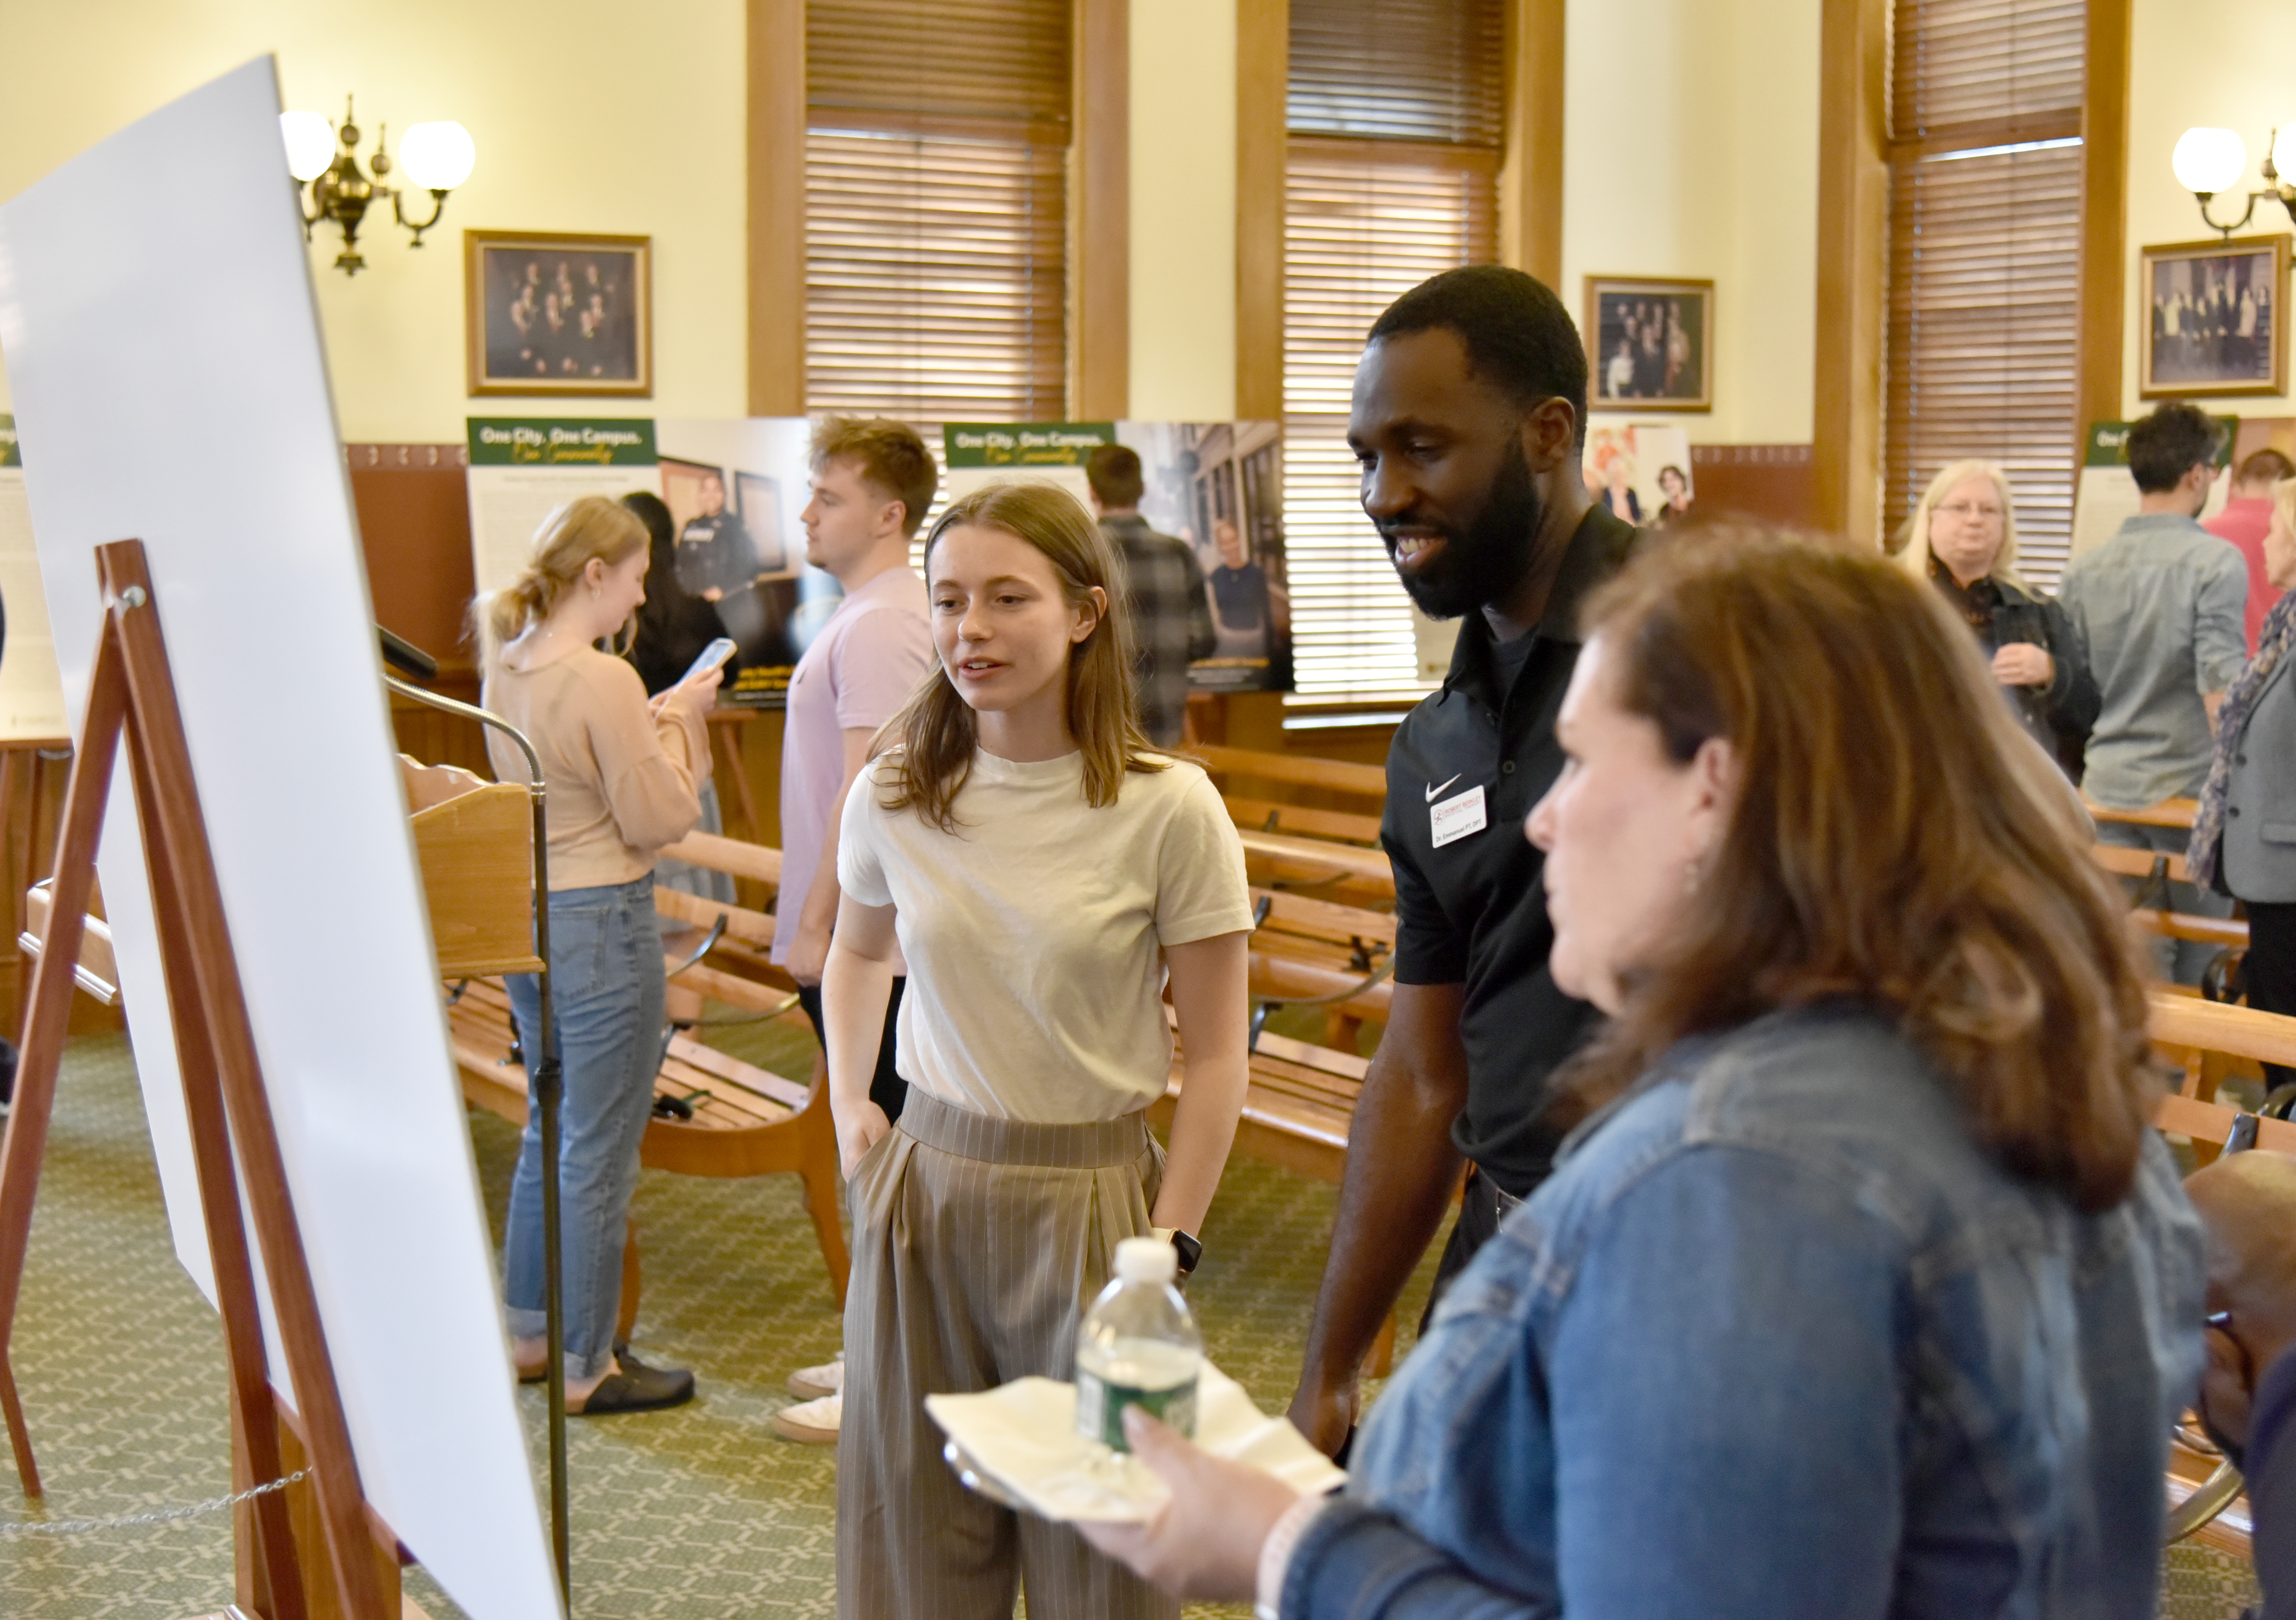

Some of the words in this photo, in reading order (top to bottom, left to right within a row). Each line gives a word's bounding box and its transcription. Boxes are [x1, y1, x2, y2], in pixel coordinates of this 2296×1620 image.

[479, 427, 512, 444] One
[549, 427, 582, 444] One
[582, 428, 643, 447] Campus.
[955, 432, 985, 448] One
[1019, 431, 1048, 447] One
[2097, 430, 2119, 447] One
[1445, 803, 1461, 814] ROBERT
[1462, 795, 1481, 807] BERKLEY
[1443, 826, 1465, 839] Emmanuel
[1473, 818, 1482, 827] DPT
